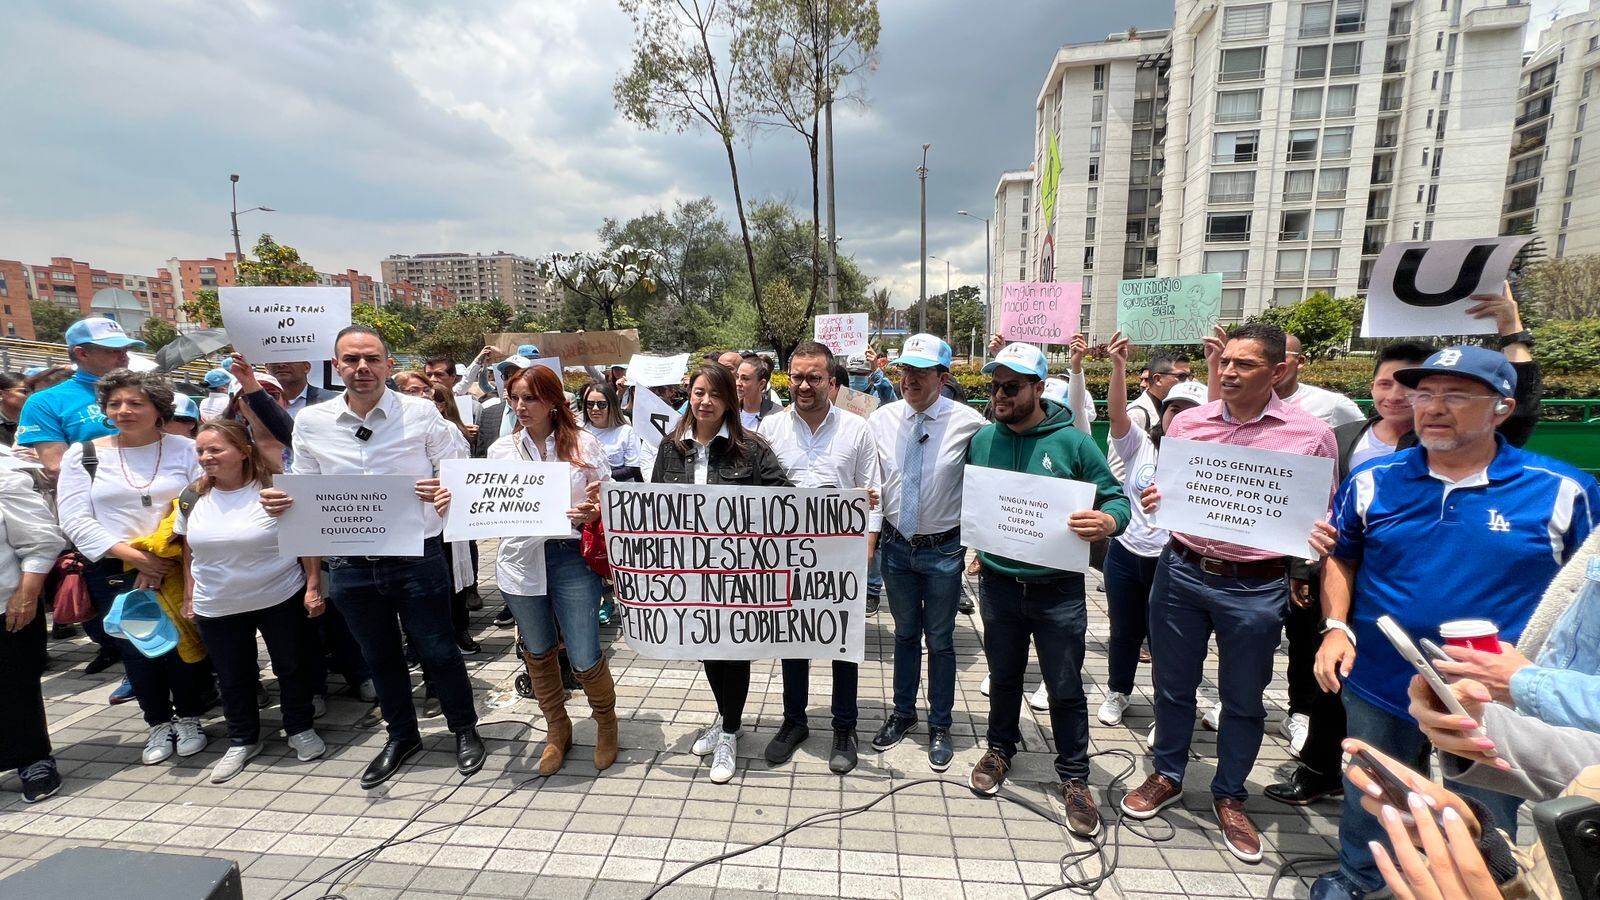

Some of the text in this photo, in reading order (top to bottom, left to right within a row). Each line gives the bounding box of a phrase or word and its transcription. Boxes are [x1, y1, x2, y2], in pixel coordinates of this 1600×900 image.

[1393, 244, 1499, 307] U
[1040, 285, 1062, 298] niño
[1122, 277, 1181, 295] UN NIÑO
[249, 303, 325, 313] LA NIÑEZ TRANS
[1004, 298, 1058, 312] nació en el
[1123, 294, 1168, 310] QUIERE
[1152, 305, 1175, 316] SER
[278, 317, 295, 329] NO
[1121, 315, 1220, 341] NO TRANS
[262, 333, 315, 346] ¡NO EXISTE!
[1188, 456, 1293, 478] ¿SI LOS GENITALES
[466, 472, 545, 485] DEJEN A LOS
[1195, 470, 1282, 490] NO DEFINEN EL
[316, 492, 387, 501] NINGÚN NIÑO
[483, 485, 524, 498] NIÑOS
[1186, 481, 1289, 505] GÉNERO, POR QUÉ
[321, 504, 354, 512] NACIÓ
[470, 500, 540, 514] SER NIÑOS
[998, 495, 1049, 510] NINGÚN NIÑO
[1188, 495, 1282, 518] REMOVERLOS LO
[608, 489, 866, 535] PROMOVER QUE LOS NIÑOS
[1001, 505, 1043, 519] NACIÓ EN EL
[1207, 511, 1257, 527] AFIRMA?
[1007, 516, 1035, 527] CUERPO
[1487, 509, 1510, 531] LA
[321, 527, 386, 535] EQUIVOCADO
[998, 523, 1044, 539] EQUIVOCADO
[609, 535, 685, 570] CAMBIEN
[786, 538, 817, 568] ES
[614, 571, 687, 602] ABUSO
[701, 573, 787, 604] INFANTIL
[620, 606, 850, 654] PETRO Y SU GOBIERNO!
